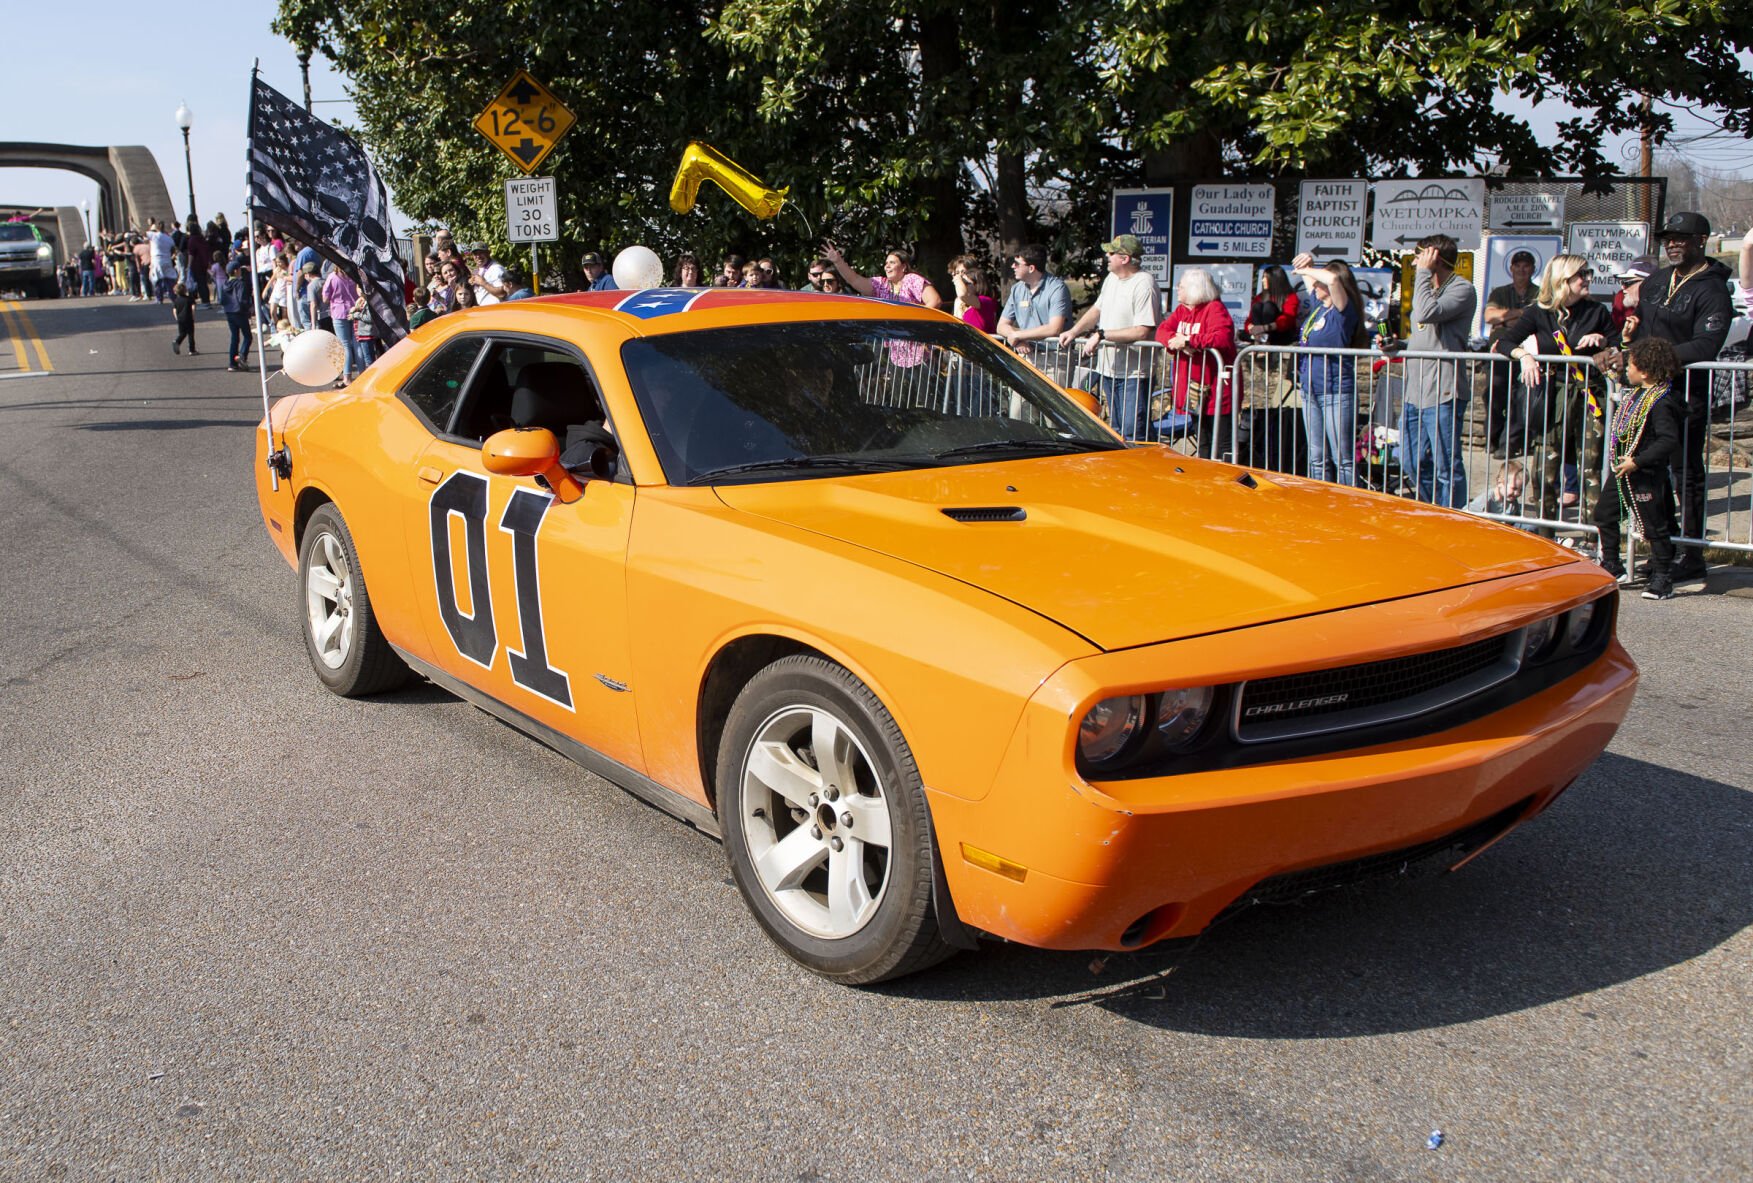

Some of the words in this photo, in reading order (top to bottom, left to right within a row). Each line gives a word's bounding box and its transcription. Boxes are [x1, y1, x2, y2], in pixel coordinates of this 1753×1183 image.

[511, 183, 550, 194] WEIGHT
[1315, 185, 1352, 195] FAITH
[1195, 188, 1219, 199] Our
[1224, 188, 1254, 202] Lady
[1258, 188, 1272, 199] of
[1494, 196, 1529, 204] RODGERS
[1531, 196, 1562, 204] CHAPEL
[517, 196, 544, 206] LIMIT
[1306, 201, 1358, 211] BAPTIST
[1199, 203, 1266, 217] Guadalupe
[1379, 207, 1479, 218] WETUMPKA
[1530, 204, 1549, 212] ZION
[522, 209, 541, 221] 30
[1510, 212, 1542, 220] CHURCH
[1303, 216, 1360, 227] CHURCH
[1381, 221, 1422, 230] Church
[1424, 221, 1435, 230] of
[1439, 220, 1473, 230] Christ
[515, 224, 550, 236] TONS
[1194, 223, 1233, 234] CATHOLIC
[1235, 223, 1269, 235] CHURCH
[1577, 228, 1641, 238] WETUMPKA
[1305, 231, 1333, 239] CHAPEL
[1335, 231, 1356, 239] ROAD
[1223, 242, 1229, 252] 5
[1232, 242, 1266, 252] MILES
[1593, 240, 1622, 249] AREA
[1598, 264, 1613, 273] OF
[429, 468, 577, 714] 01
[1246, 693, 1349, 716] CHALLENGER
